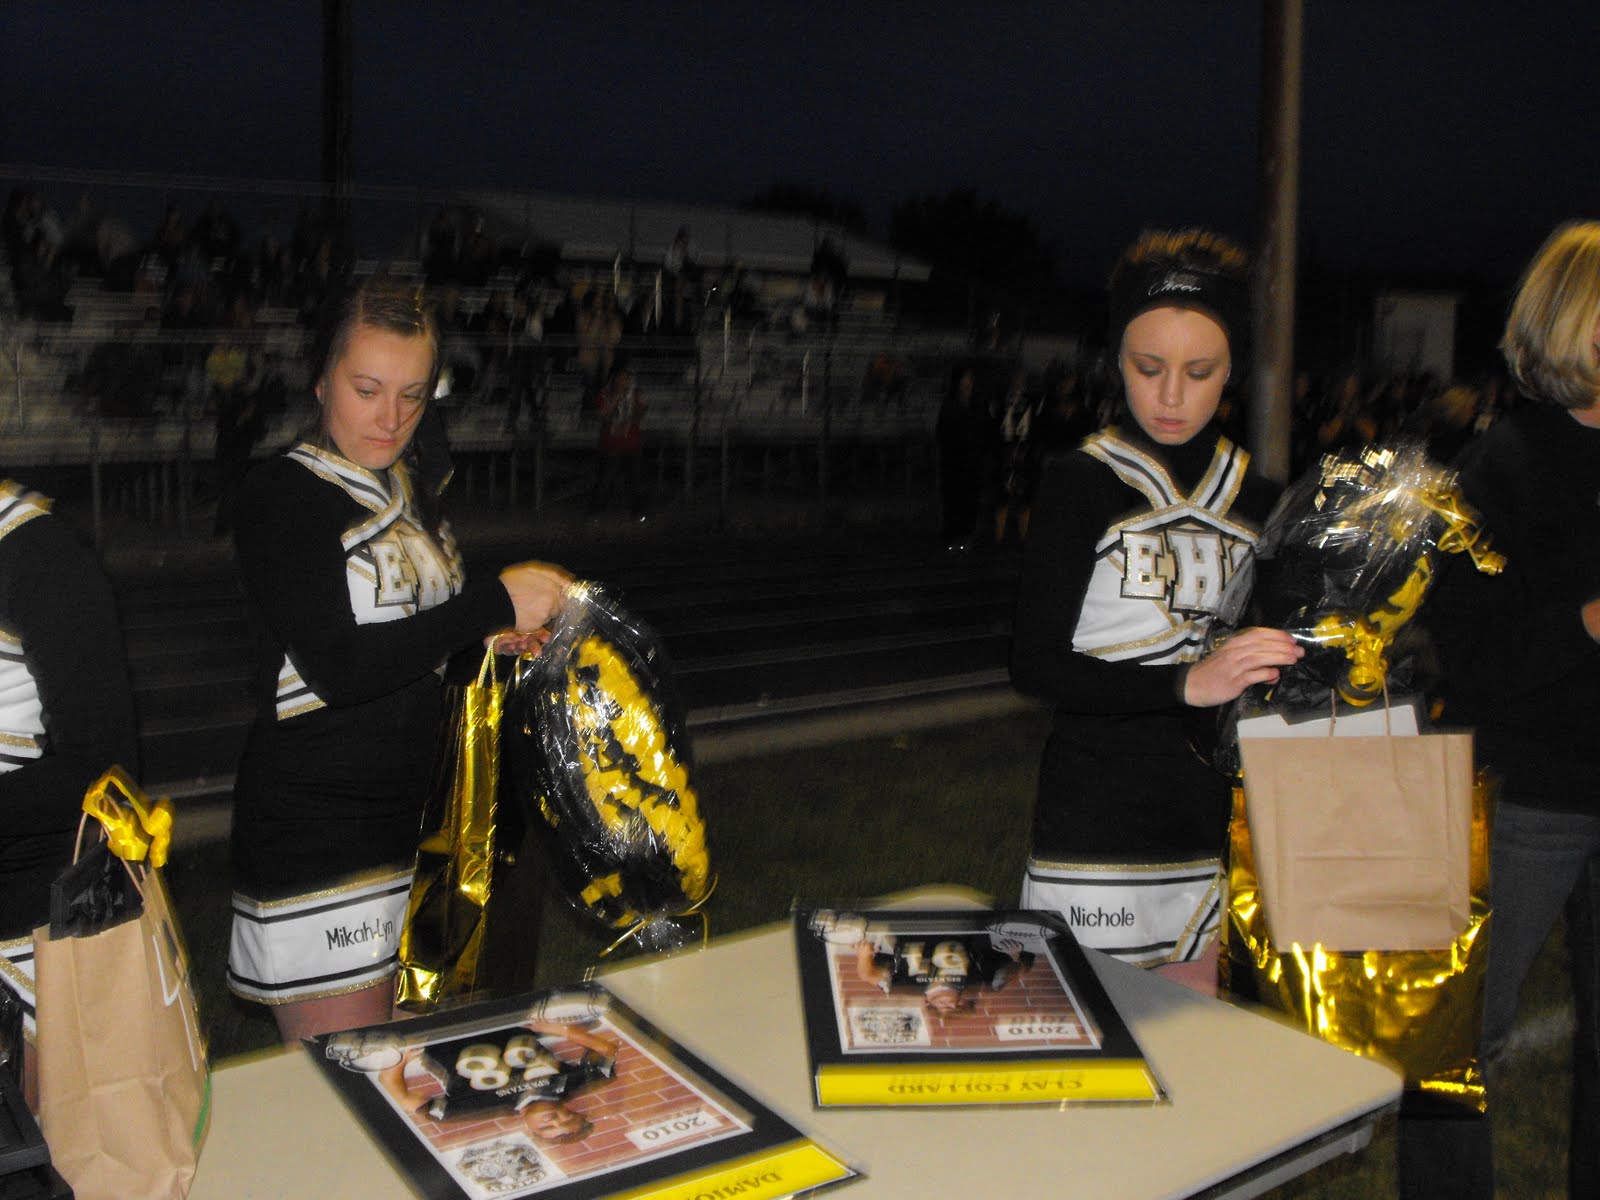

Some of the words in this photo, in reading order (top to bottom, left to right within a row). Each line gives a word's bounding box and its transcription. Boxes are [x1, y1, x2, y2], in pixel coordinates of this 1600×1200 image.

[368, 532, 462, 611] EH
[1120, 529, 1251, 613] EH
[1070, 906, 1135, 927] Nichole
[326, 918, 393, 950] Mikah-Lyn
[1008, 1026, 1069, 1036] 2010
[456, 1036, 560, 1091] 58
[495, 1079, 550, 1098] SPARTANS
[888, 1084, 1010, 1095] COLLARD
[1019, 1080, 1082, 1092] CLAY
[642, 1117, 706, 1140] 2010
[687, 1173, 783, 1200] DAMIO
